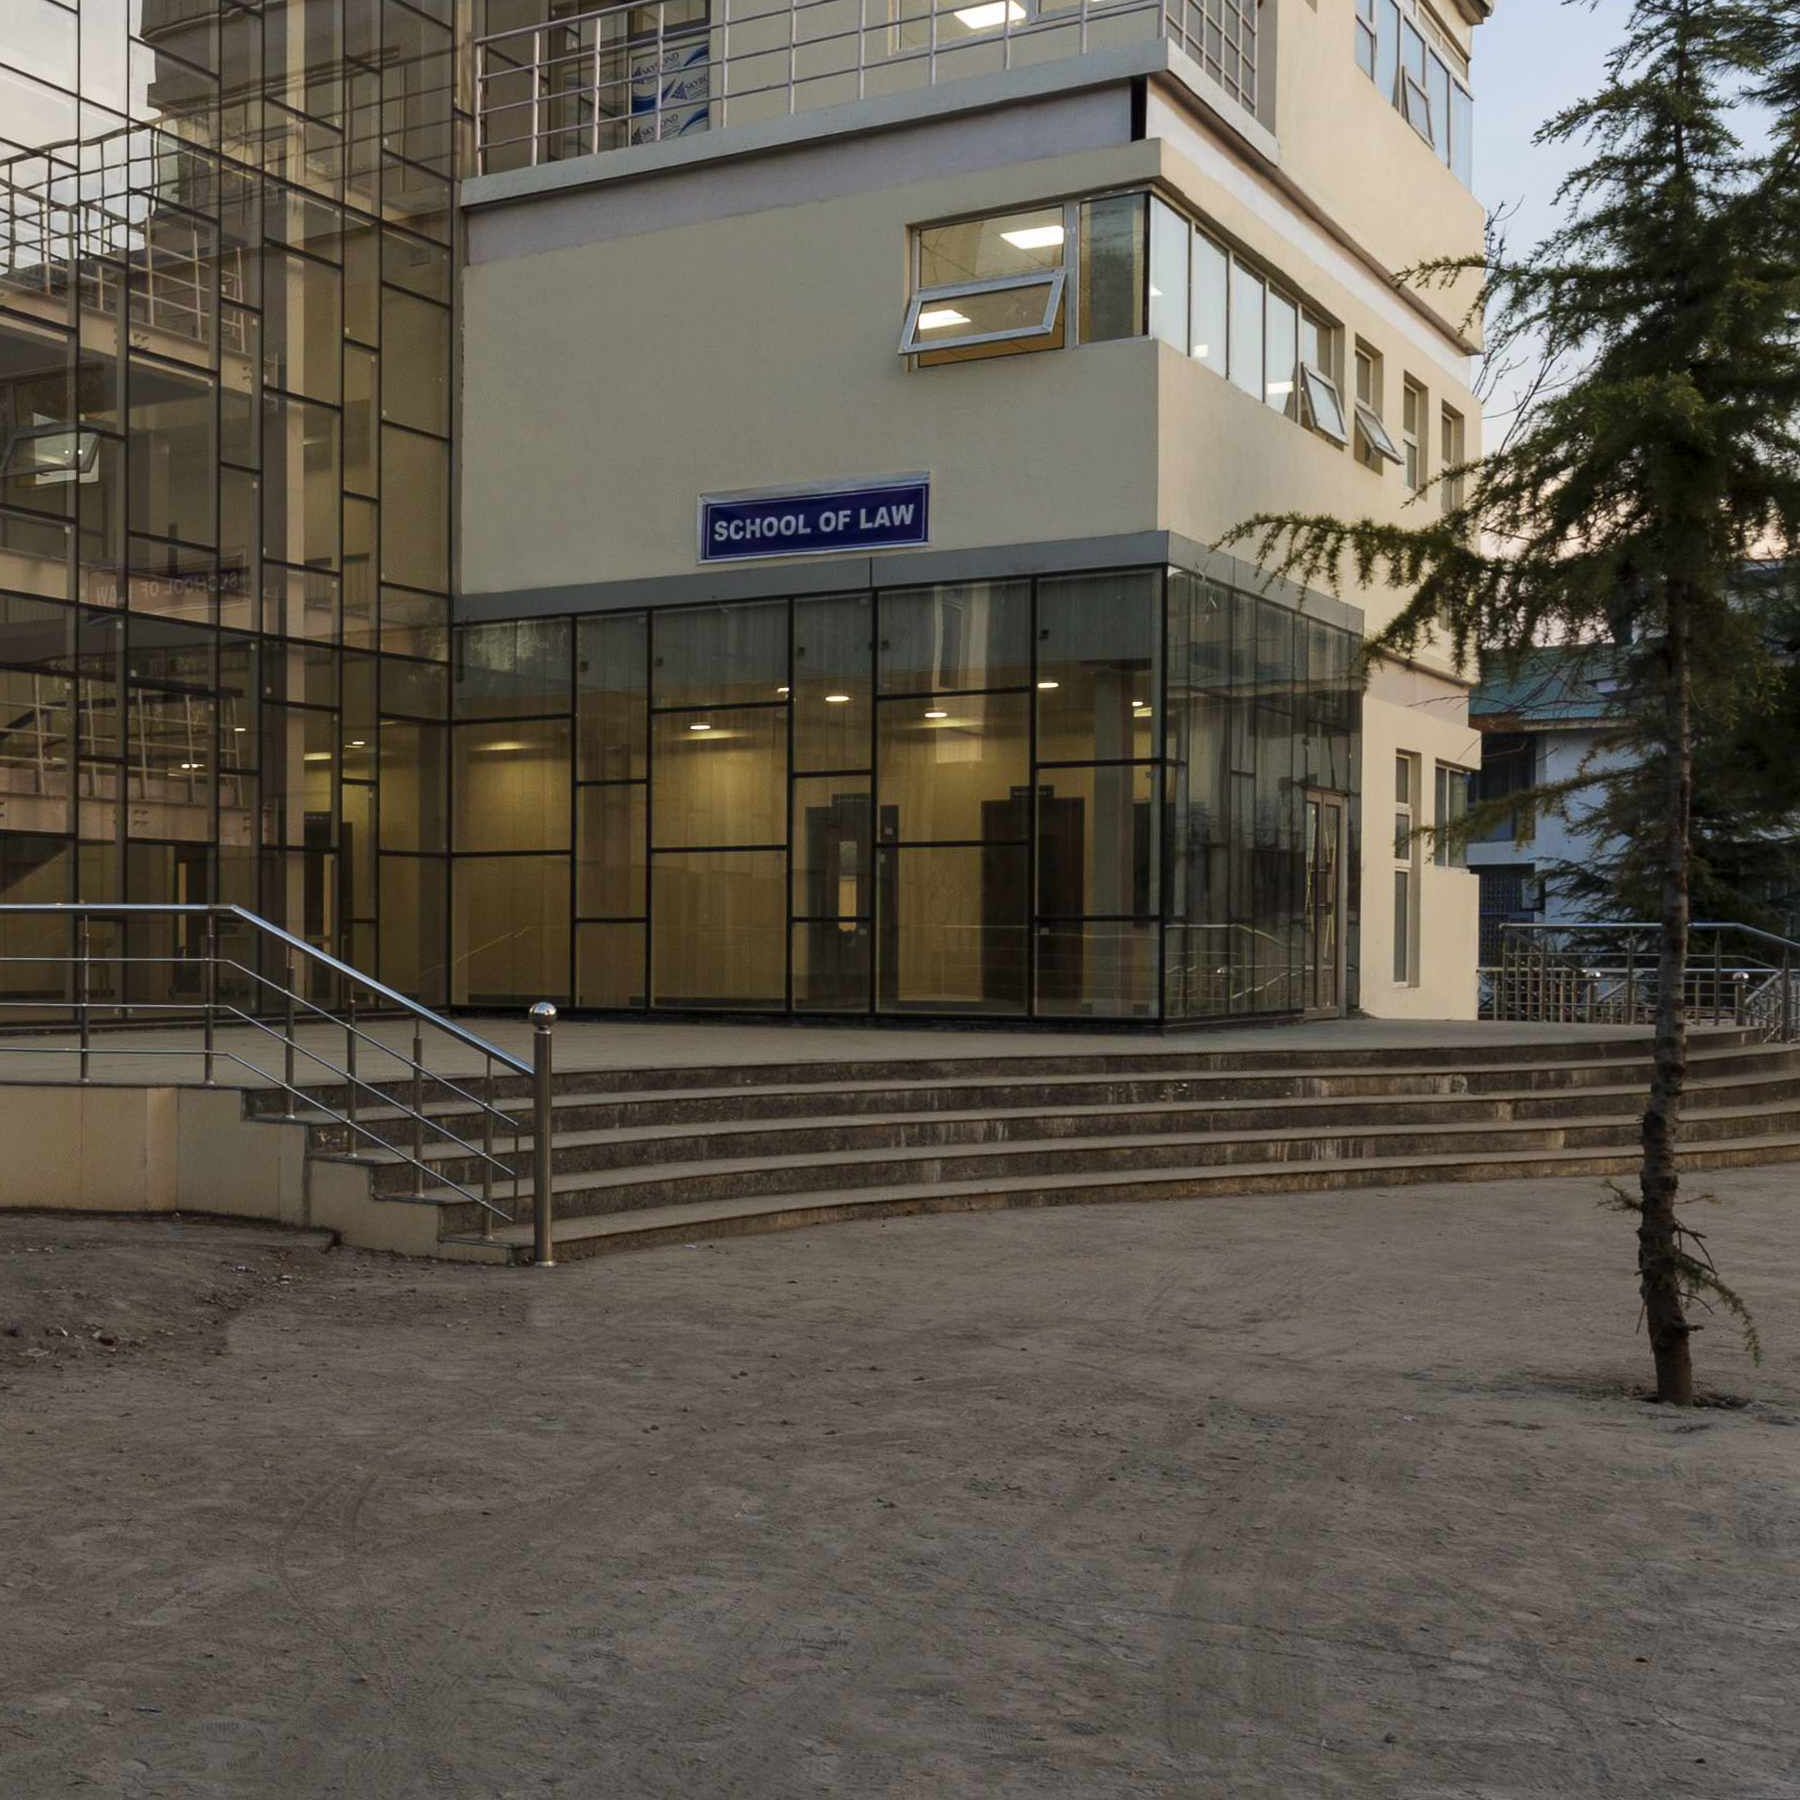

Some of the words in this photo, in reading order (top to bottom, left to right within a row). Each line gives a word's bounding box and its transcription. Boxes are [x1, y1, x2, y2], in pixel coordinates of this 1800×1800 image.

[642, 51, 680, 75] SKYOND
[641, 113, 679, 137] SKYOND
[714, 514, 811, 542] SCHOOL
[819, 510, 851, 533] OF
[860, 503, 915, 530] LAW
